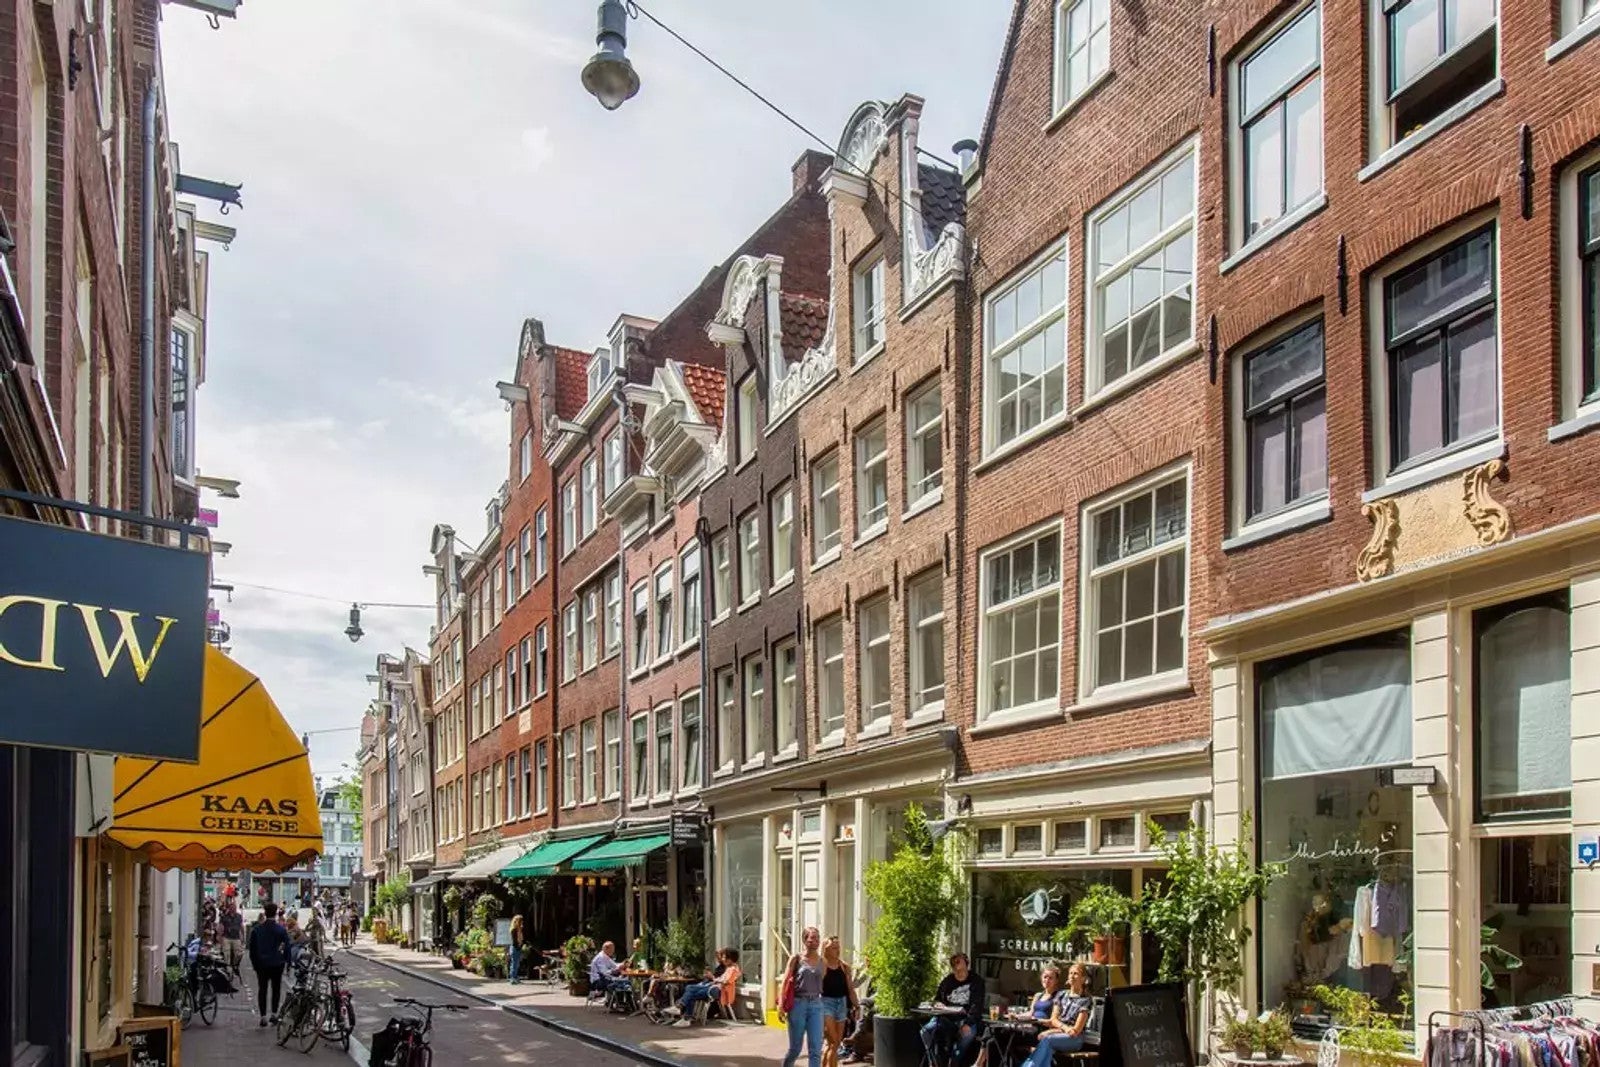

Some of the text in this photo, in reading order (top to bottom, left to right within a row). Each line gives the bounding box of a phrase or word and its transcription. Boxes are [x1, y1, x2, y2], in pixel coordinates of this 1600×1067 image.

[201, 794, 298, 816] KAAS
[201, 816, 298, 833] CHEESE
[1290, 839, 1381, 865] the darling
[1000, 939, 1073, 953] SCREAMING
[1015, 958, 1051, 972] BEAN
